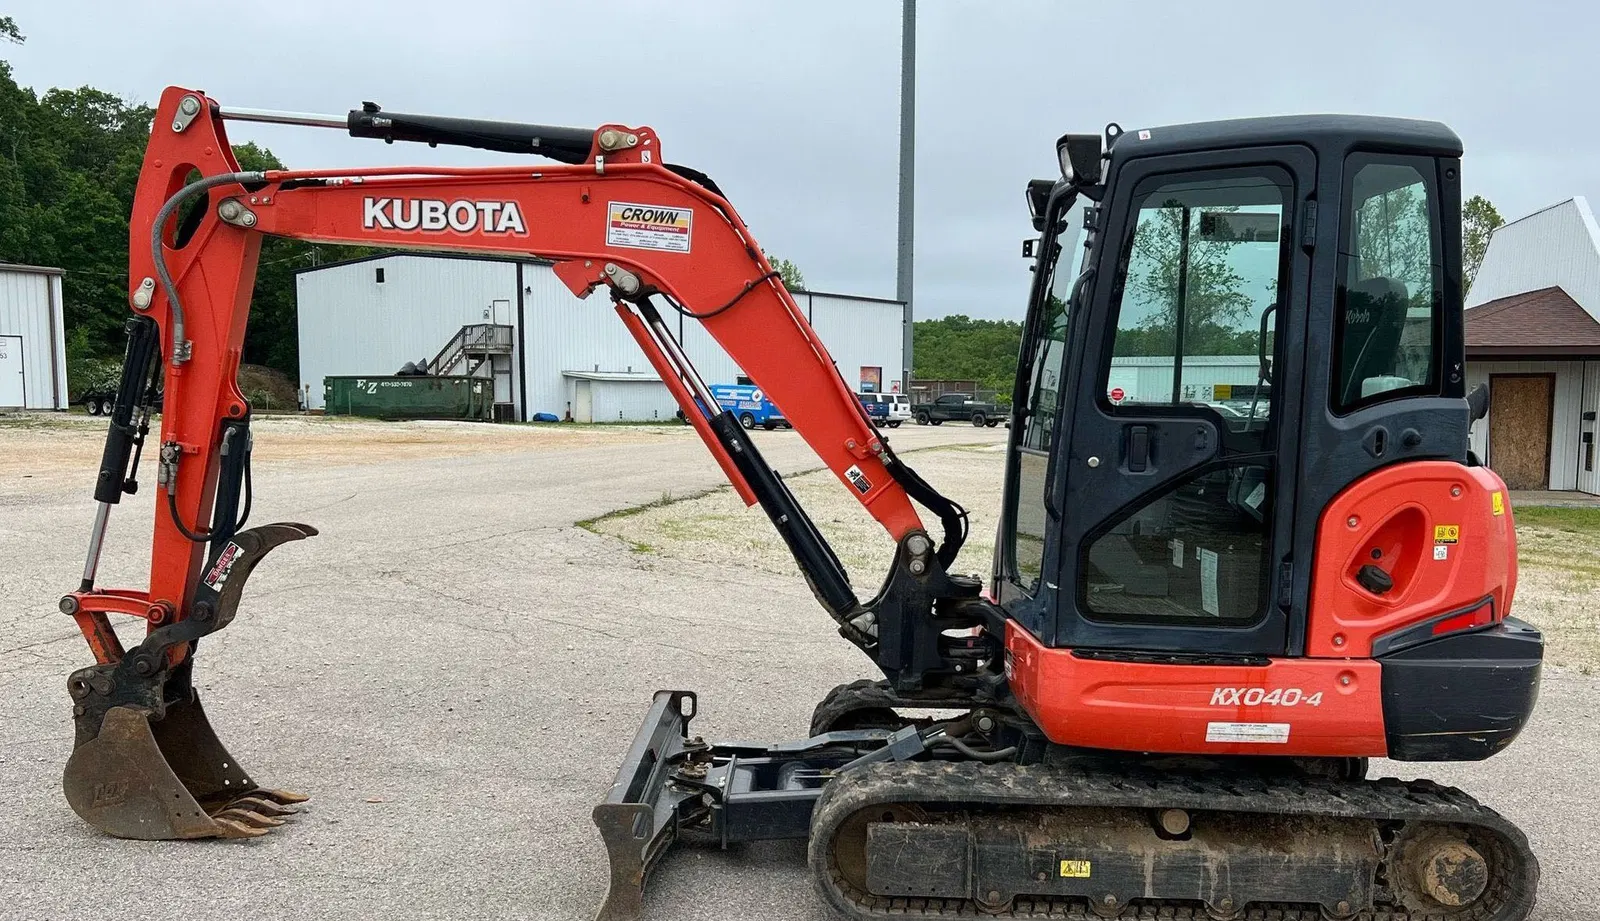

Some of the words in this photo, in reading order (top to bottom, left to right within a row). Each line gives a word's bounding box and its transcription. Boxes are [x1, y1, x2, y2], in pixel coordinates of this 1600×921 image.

[364, 197, 525, 233] KUBOTA
[621, 207, 679, 225] CROWN
[646, 224, 680, 232] Equipment
[213, 553, 231, 577] DANGER
[1210, 687, 1323, 706] KX040-4
